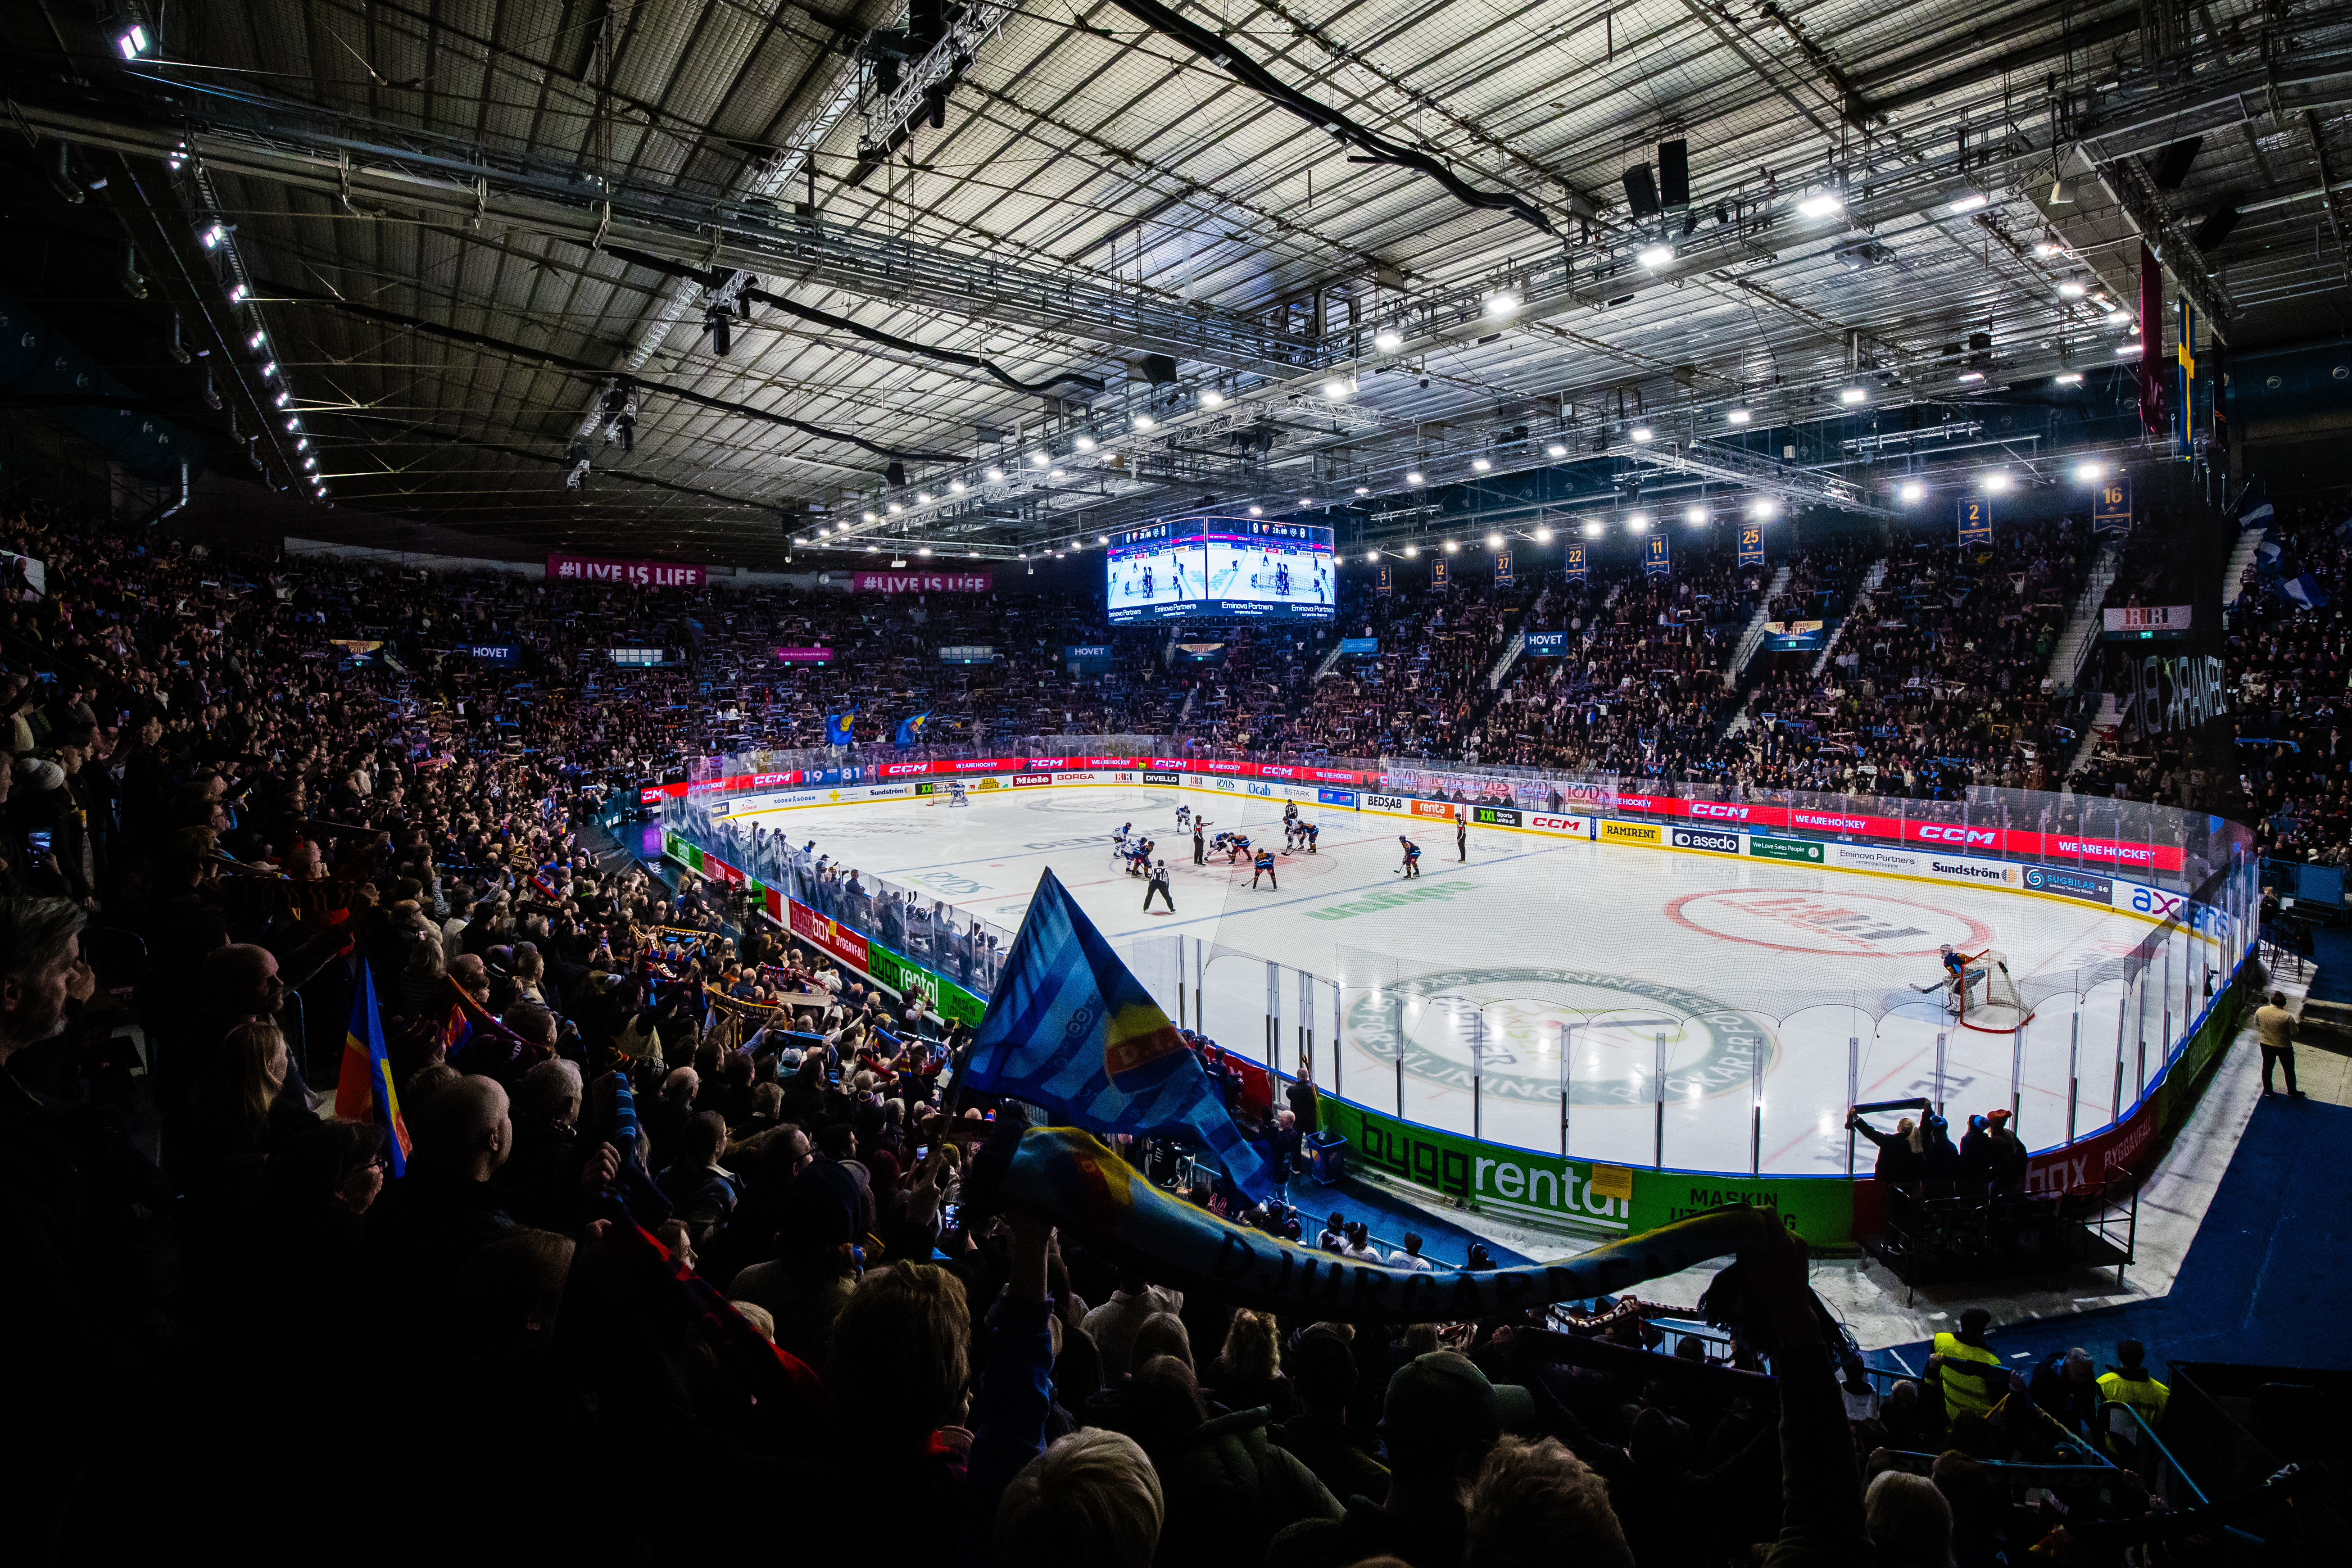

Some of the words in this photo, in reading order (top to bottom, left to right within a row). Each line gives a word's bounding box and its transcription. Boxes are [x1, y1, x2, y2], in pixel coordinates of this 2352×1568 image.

[2102, 487, 2122, 504] 16
[1969, 504, 1979, 520] 2
[1161, 526, 1165, 536] 0
[1253, 523, 1259, 533] 0
[1300, 528, 1305, 538] 0
[1126, 533, 1130, 543] 0
[1140, 531, 1151, 539] 20:00
[1743, 530, 1759, 544] 25
[1652, 541, 1662, 554] 11
[1568, 550, 1582, 562] 22
[1498, 557, 1509, 569] 27
[559, 562, 622, 581] #LIVE
[629, 566, 649, 584] IS
[656, 567, 696, 585] LIFE
[1381, 571, 1386, 581] 5
[1435, 565, 1444, 576] 12
[863, 577, 919, 593] #LIVE
[924, 578, 942, 591] IS
[948, 578, 984, 593] LIFE
[1222, 601, 1248, 609] Eminova
[1248, 602, 1273, 611] Partners
[1291, 604, 1314, 613] Eminova
[1314, 605, 1334, 613] Partners
[1529, 635, 1563, 645] HOVET
[473, 647, 508, 657] HOVET
[1075, 648, 1105, 656] HOVET
[888, 764, 927, 773] CCM
[1029, 759, 1064, 767] CCM
[1155, 759, 1187, 768] CCM
[804, 770, 823, 782] 19
[843, 767, 860, 779] 81
[1262, 766, 1293, 776] CCM
[753, 773, 791, 784] CCM
[1016, 775, 1049, 785] Miele
[1146, 775, 1178, 783] DIVELLO
[1217, 778, 1234, 789] RYDS
[870, 788, 904, 796] Sundström
[921, 784, 933, 793] XX
[1248, 782, 1271, 797] Ocab
[1288, 789, 1310, 798] STARK
[642, 789, 664, 801] CM
[1368, 795, 1402, 811] BEDSAB
[1419, 802, 1446, 814] renta
[1622, 798, 1652, 807] HOCKEY
[1479, 809, 1496, 822] XXL
[1691, 803, 1749, 819] CCM
[1532, 816, 1581, 831] CCM
[1795, 815, 1809, 824] WE
[1810, 816, 1827, 825] ARE
[1828, 817, 1866, 829] HOCKEY
[1606, 825, 1656, 839] RAMIRENT
[1919, 825, 1996, 845] CCM
[1693, 835, 1737, 851] asedo
[1787, 845, 1805, 853] People
[1840, 849, 1875, 861] Eminova
[1876, 853, 1916, 865] Partners
[2059, 841, 2078, 853] WE
[2081, 843, 2103, 855] ARE
[2103, 847, 2156, 861] HOCKEY
[1932, 861, 2000, 880] Sundström
[2047, 874, 2109, 893] SUGBILAR.se
[836, 934, 867, 962] BYGGAVFALL
[952, 993, 976, 1015] MASKIN
[947, 1004, 980, 1028] UTHYRNIN
[2104, 1114, 2151, 1170] BYGGAVFALL
[1690, 1188, 1778, 1208] MASKIN
